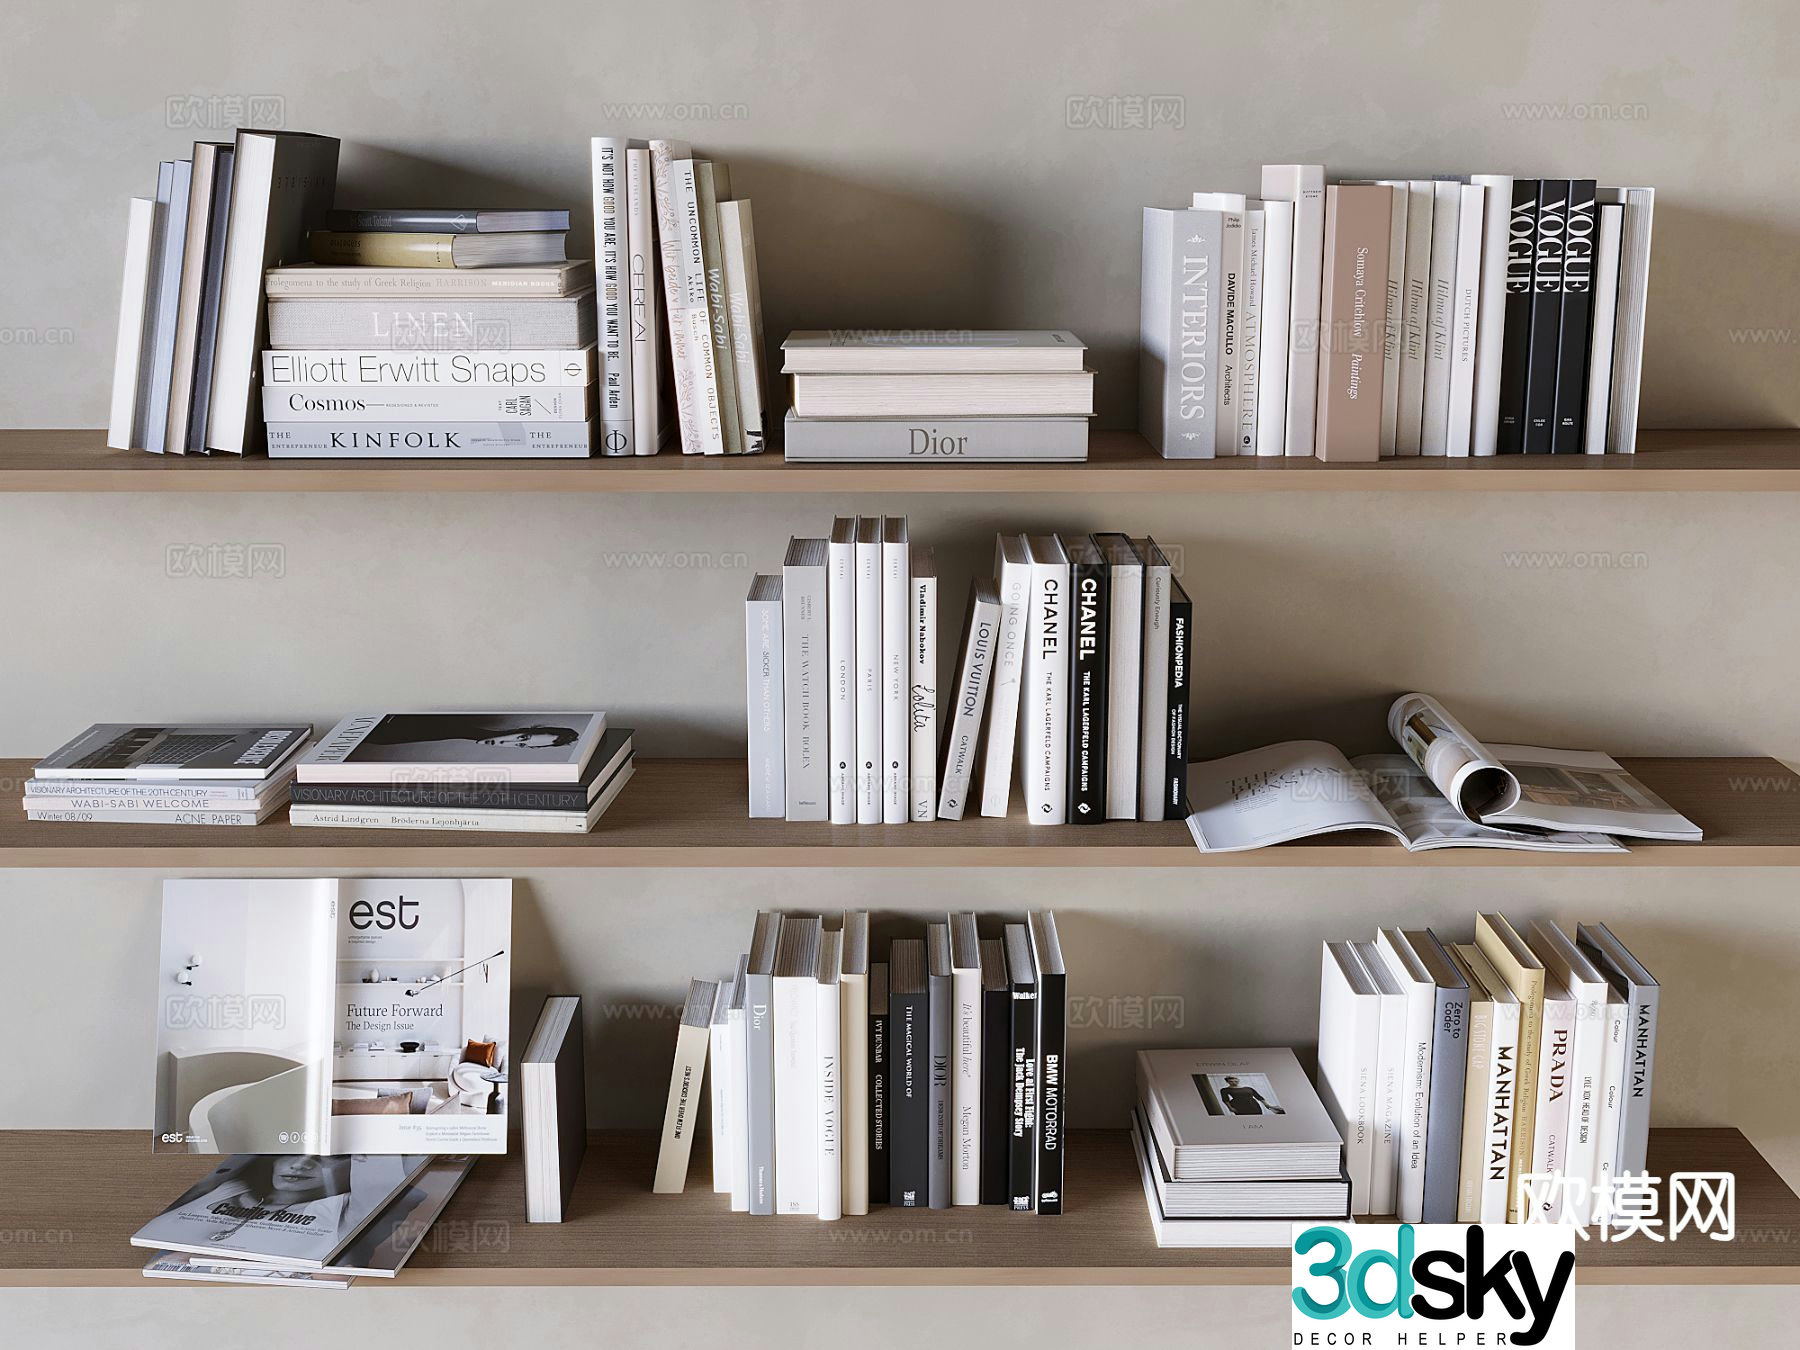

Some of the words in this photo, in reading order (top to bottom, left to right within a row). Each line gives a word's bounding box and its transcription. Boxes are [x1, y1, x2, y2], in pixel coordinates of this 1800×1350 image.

[601, 147, 614, 160] IT'S
[601, 163, 615, 177] NOT
[684, 170, 693, 193] THE
[602, 178, 615, 195] HOW
[603, 196, 616, 215] GOOD
[603, 217, 617, 231] YOU
[687, 201, 701, 264] UNCOMMON
[603, 232, 617, 247] ARE,
[1506, 198, 1536, 293] VOGUE
[1535, 198, 1565, 293] VOGUE
[605, 251, 617, 265] IT'S
[1250, 249, 1258, 276] Michael
[1355, 247, 1369, 287] Somaya
[316, 279, 324, 288] to
[327, 277, 339, 288] the
[341, 278, 361, 290] study
[364, 277, 372, 288] of
[374, 277, 397, 288] Greek
[400, 277, 432, 290] Religion
[605, 266, 617, 281] HOW
[695, 273, 706, 302] LIFE
[605, 283, 618, 300] GOOD
[632, 254, 647, 354] CEREAL
[1226, 273, 1236, 307] DAVIDE
[1249, 279, 1257, 307] Howard
[1410, 279, 1423, 314] Hilma
[1464, 288, 1472, 319] DUTCH
[605, 303, 618, 317] YOU
[698, 310, 707, 324] OF
[707, 269, 728, 350] Wabi-Sabi
[1353, 289, 1367, 337] Critchlow
[372, 311, 474, 337] LINEN
[606, 319, 619, 338] WANT
[1180, 255, 1209, 420] INTERIORS
[1225, 309, 1235, 356] MACULLO
[607, 339, 619, 349] TO
[1408, 331, 1421, 360] Klint
[1462, 322, 1471, 362] PICTURES
[271, 355, 348, 383] Elliott
[359, 355, 440, 383] Erwitt
[451, 354, 546, 387] Snaps
[701, 334, 713, 379] COMMON
[1241, 311, 1257, 430] ATMOSPHERE
[608, 372, 620, 387] Paul
[1223, 365, 1234, 405] Architects
[1349, 353, 1363, 399] Paintings
[289, 393, 366, 411] Cosmos
[505, 398, 518, 414] CARL
[519, 395, 532, 416] SAGAN
[608, 388, 620, 409] Arden
[707, 387, 720, 440] OBJECTS
[330, 432, 461, 448] KINFOLK
[908, 428, 968, 456] Dior
[919, 584, 927, 623] Vladimir
[1153, 577, 1162, 605] Curiously
[1042, 579, 1059, 660] CHANEL
[1079, 578, 1097, 661] CHANEL
[918, 626, 926, 665] Nabokov
[974, 622, 991, 659] LOUIS
[1174, 617, 1184, 689] FASHIONPEDIA
[963, 663, 984, 717] VUITTON
[1083, 671, 1091, 685] THE
[912, 684, 935, 733] Lolita
[1082, 687, 1090, 706] KARL
[802, 702, 810, 729] BOOK
[1082, 708, 1090, 749] LAGERFELD
[955, 735, 968, 775] CATWALK
[1081, 750, 1089, 792] CAMPAIGNS
[31, 786, 65, 794] VISIONARY
[66, 787, 119, 796] ARCHITECTURE
[120, 788, 130, 796] OF
[131, 788, 148, 796] THE
[148, 788, 169, 796] 20TH
[170, 789, 208, 797] CENTURY
[71, 800, 139, 808] WABI-SABI
[143, 799, 209, 808] WELCOME
[37, 812, 63, 820] Winter
[65, 812, 93, 821] 08/09
[175, 813, 206, 824] ACNE
[212, 814, 242, 825] PAPER
[313, 814, 339, 822] Astrid
[341, 814, 379, 824] Lindgren
[918, 800, 928, 818] VN
[349, 895, 419, 930] est
[347, 1003, 388, 1017] Future
[392, 1003, 443, 1017] Forward
[753, 1004, 767, 1030] Dior
[905, 1005, 913, 1021] THE
[1443, 1002, 1454, 1033] Coder
[1453, 1002, 1464, 1025] Zero
[346, 1021, 361, 1031] The
[363, 1021, 392, 1032] Design
[393, 1021, 414, 1031] Issue
[875, 1020, 883, 1033] IVY
[905, 1023, 913, 1055] MAGICAL
[962, 1015, 973, 1055] beautiful
[1452, 1027, 1462, 1039] to
[1613, 1019, 1621, 1043] Colour
[1632, 1004, 1651, 1098] MANHATTAN
[823, 1056, 834, 1102] INSIDE
[905, 1058, 913, 1086] WORLD
[933, 1055, 947, 1087] DIOR
[1046, 1054, 1059, 1086] BMW
[1415, 1042, 1427, 1089] Modernism:
[1549, 1030, 1568, 1102] PRADA
[875, 1074, 883, 1118] COLLECTED
[905, 1088, 913, 1098] OF
[959, 1106, 972, 1136] Megan
[1045, 1087, 1058, 1150] MOTORRAD
[1414, 1092, 1424, 1127] Evolution
[1489, 1046, 1514, 1180] MANHATTAN
[161, 1132, 183, 1143] est
[824, 1109, 835, 1156] VOGUE
[875, 1119, 883, 1150] STORIES
[1412, 1131, 1419, 1140] of
[1412, 1140, 1419, 1150] an
[962, 1138, 971, 1170] Morton
[1411, 1152, 1420, 1169] Idea
[269, 1209, 316, 1226] Rowe
